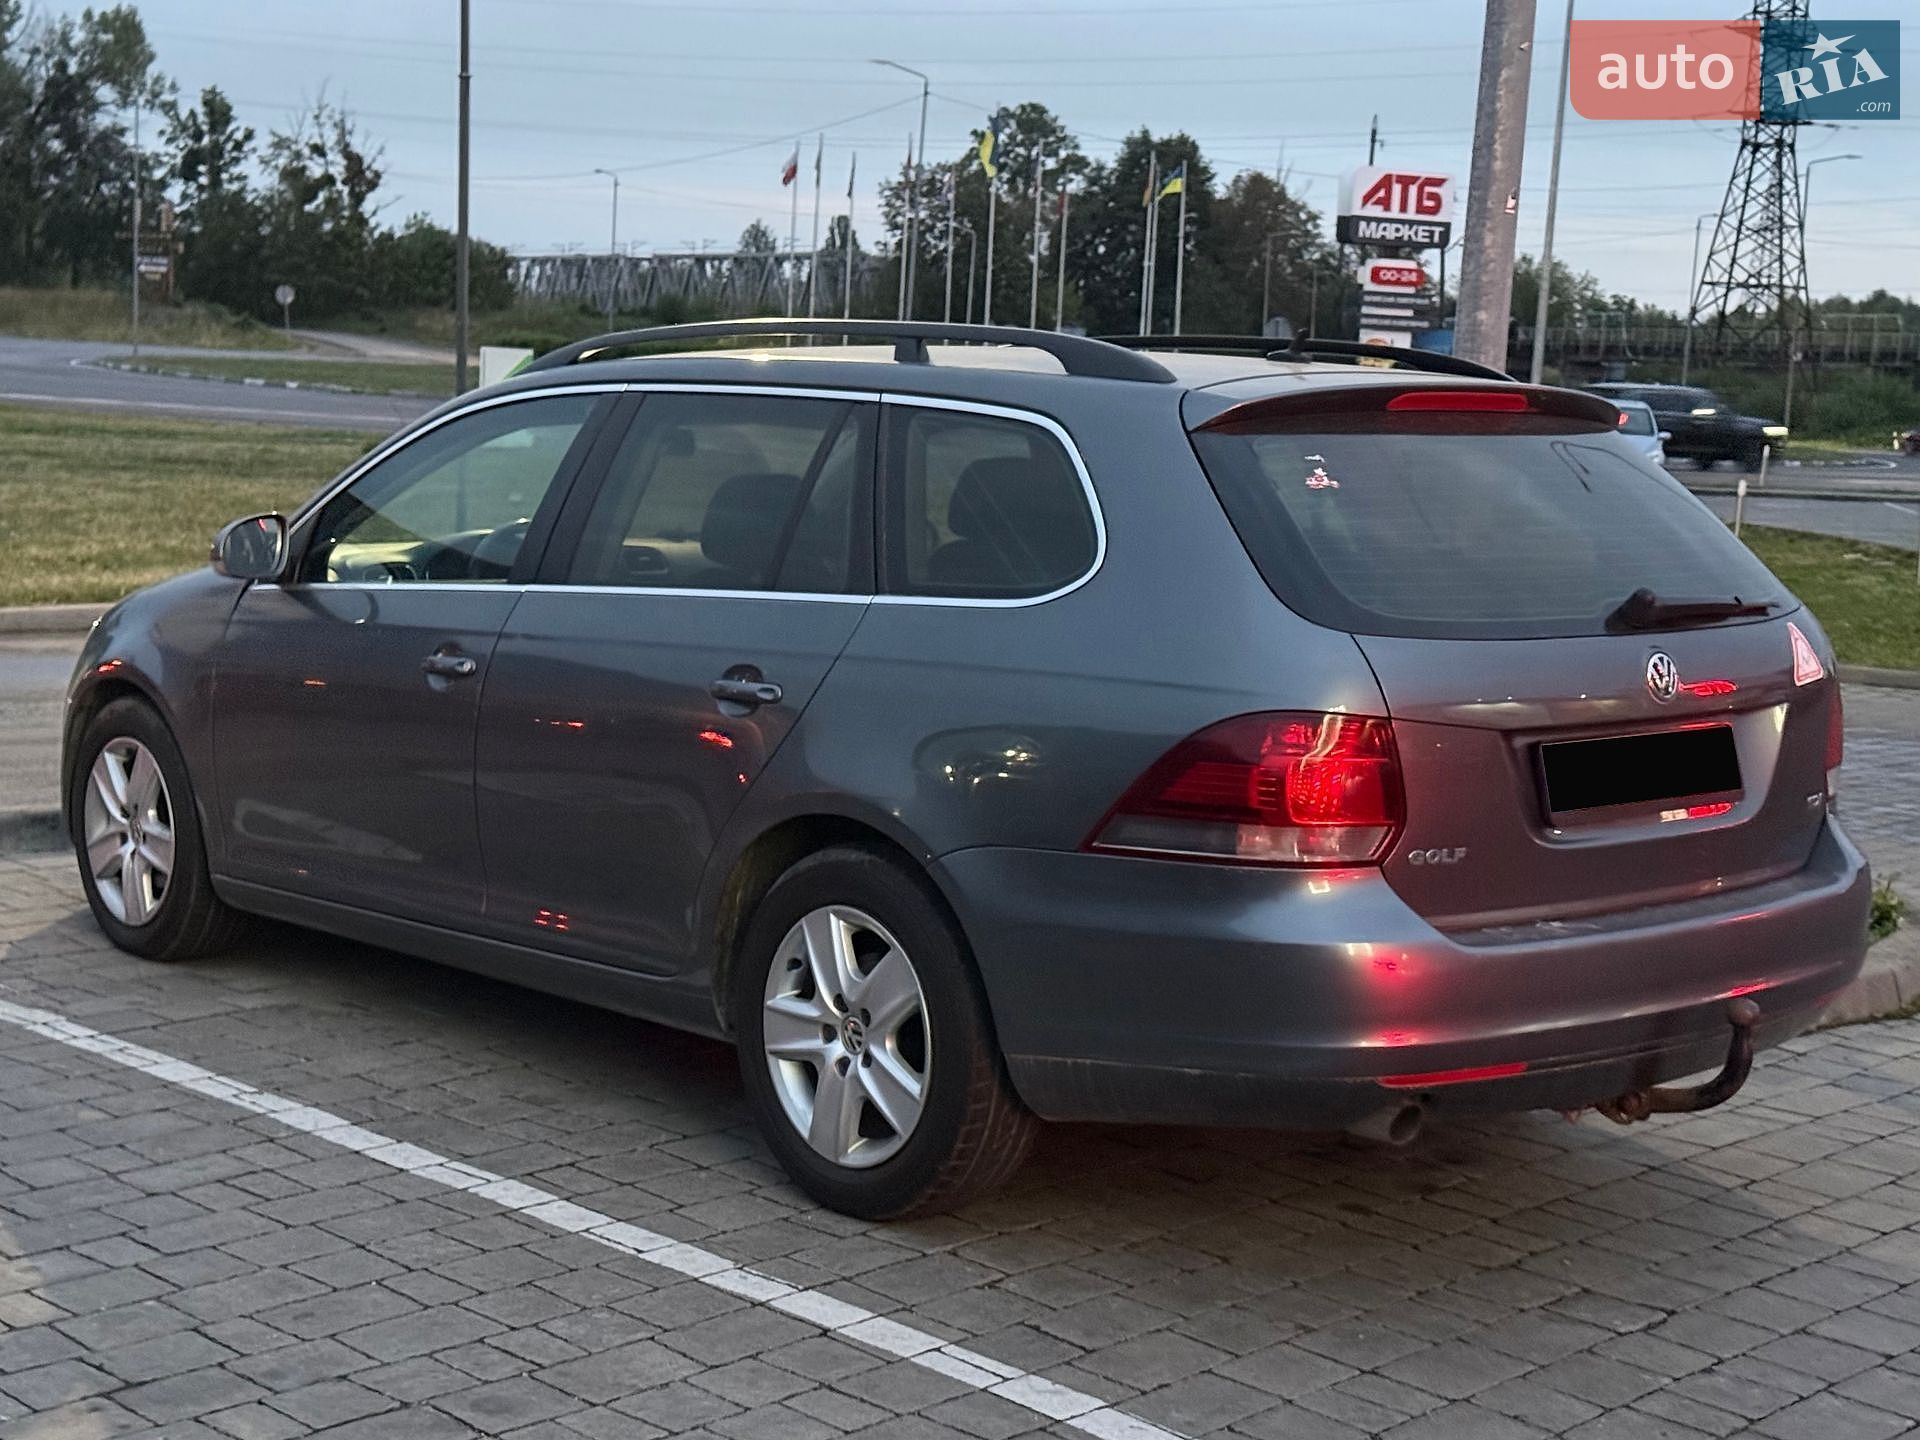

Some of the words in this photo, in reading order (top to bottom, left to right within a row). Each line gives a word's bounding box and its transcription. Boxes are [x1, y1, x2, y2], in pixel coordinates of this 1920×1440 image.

[1361, 173, 1449, 216] АТБ
[1357, 220, 1446, 243] МАРКЕТ
[1408, 847, 1467, 865] GOLF
